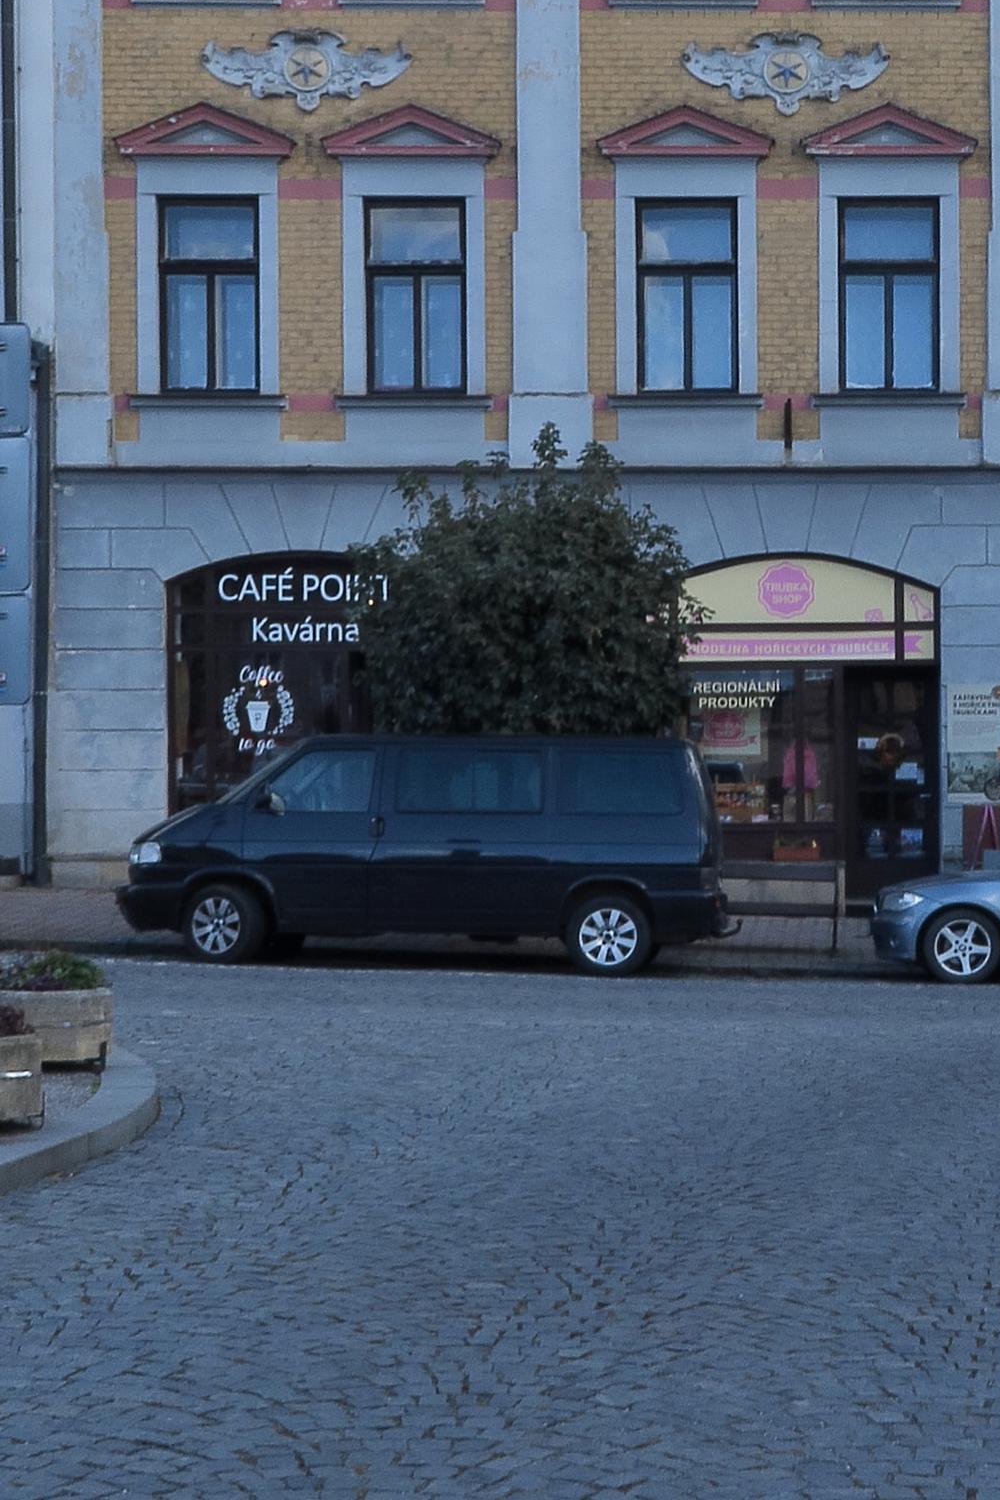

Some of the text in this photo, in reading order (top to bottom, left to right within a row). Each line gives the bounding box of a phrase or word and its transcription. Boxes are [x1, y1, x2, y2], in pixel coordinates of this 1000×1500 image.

[218, 566, 294, 602] CAFÉ
[764, 581, 808, 593] TRUBKA
[772, 593, 802, 605] SHOP
[252, 615, 360, 642] Kavárna
[830, 640, 890, 654] TRUBIČEK
[240, 664, 284, 687] Coffee
[693, 678, 781, 694] REGIONÁLNÍ
[698, 696, 776, 709] PRODUKTY
[239, 738, 276, 756] to go
